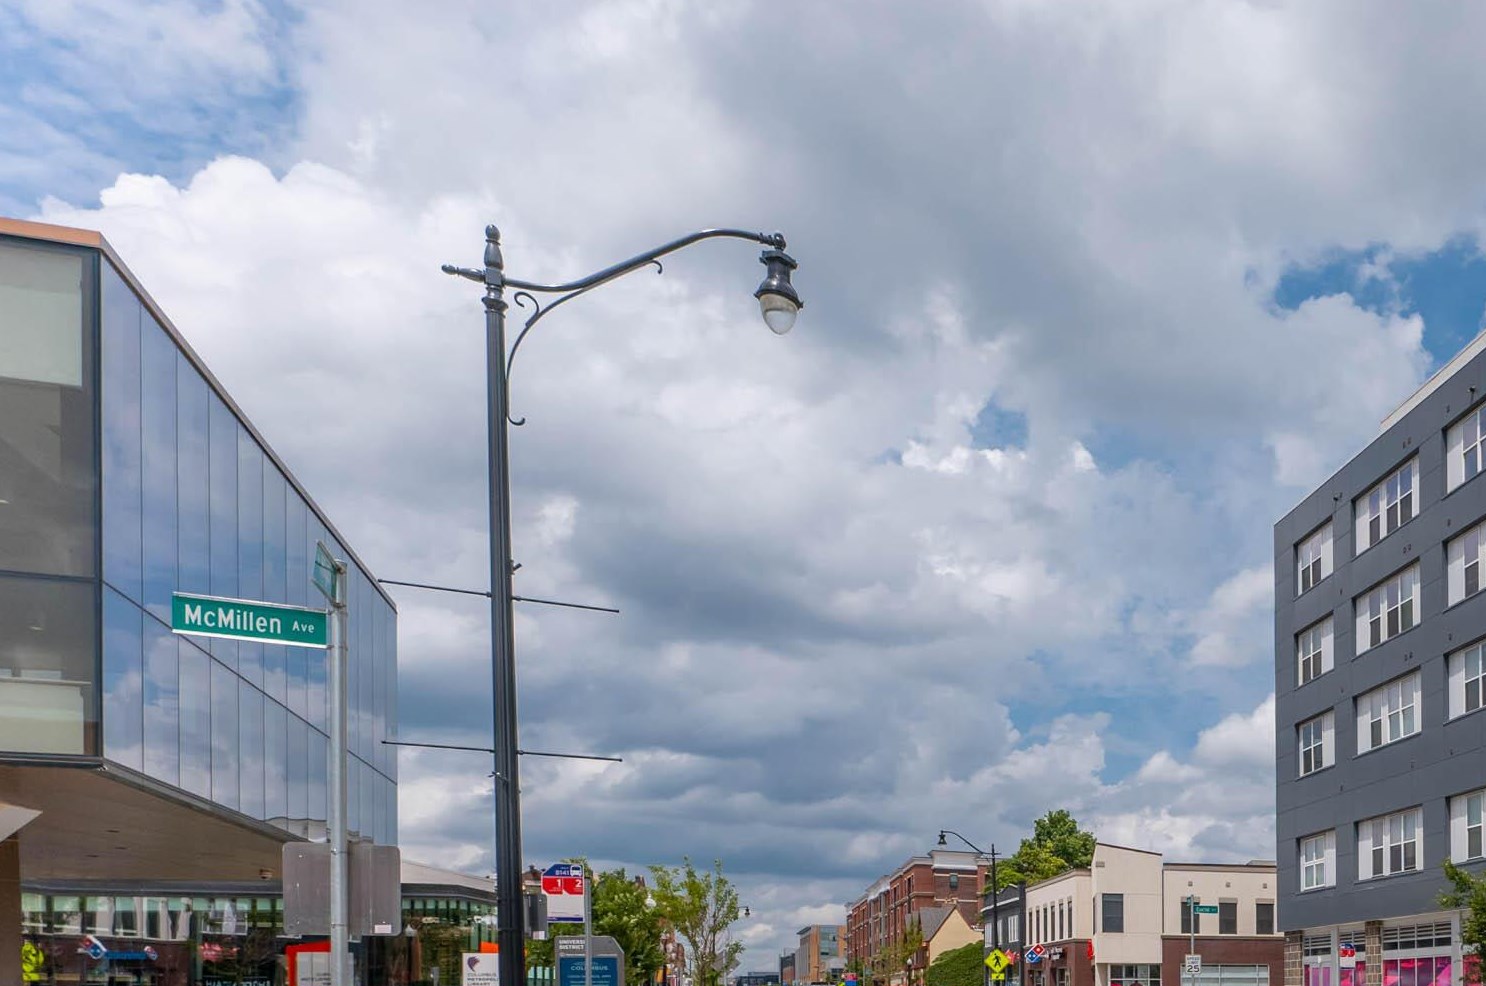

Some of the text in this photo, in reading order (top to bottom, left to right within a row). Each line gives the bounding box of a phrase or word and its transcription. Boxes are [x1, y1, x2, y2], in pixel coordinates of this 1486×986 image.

[184, 604, 315, 634] McMillen Ave
[556, 879, 562, 888] 1
[575, 879, 582, 888] 2
[1187, 965, 1200, 973] 25
